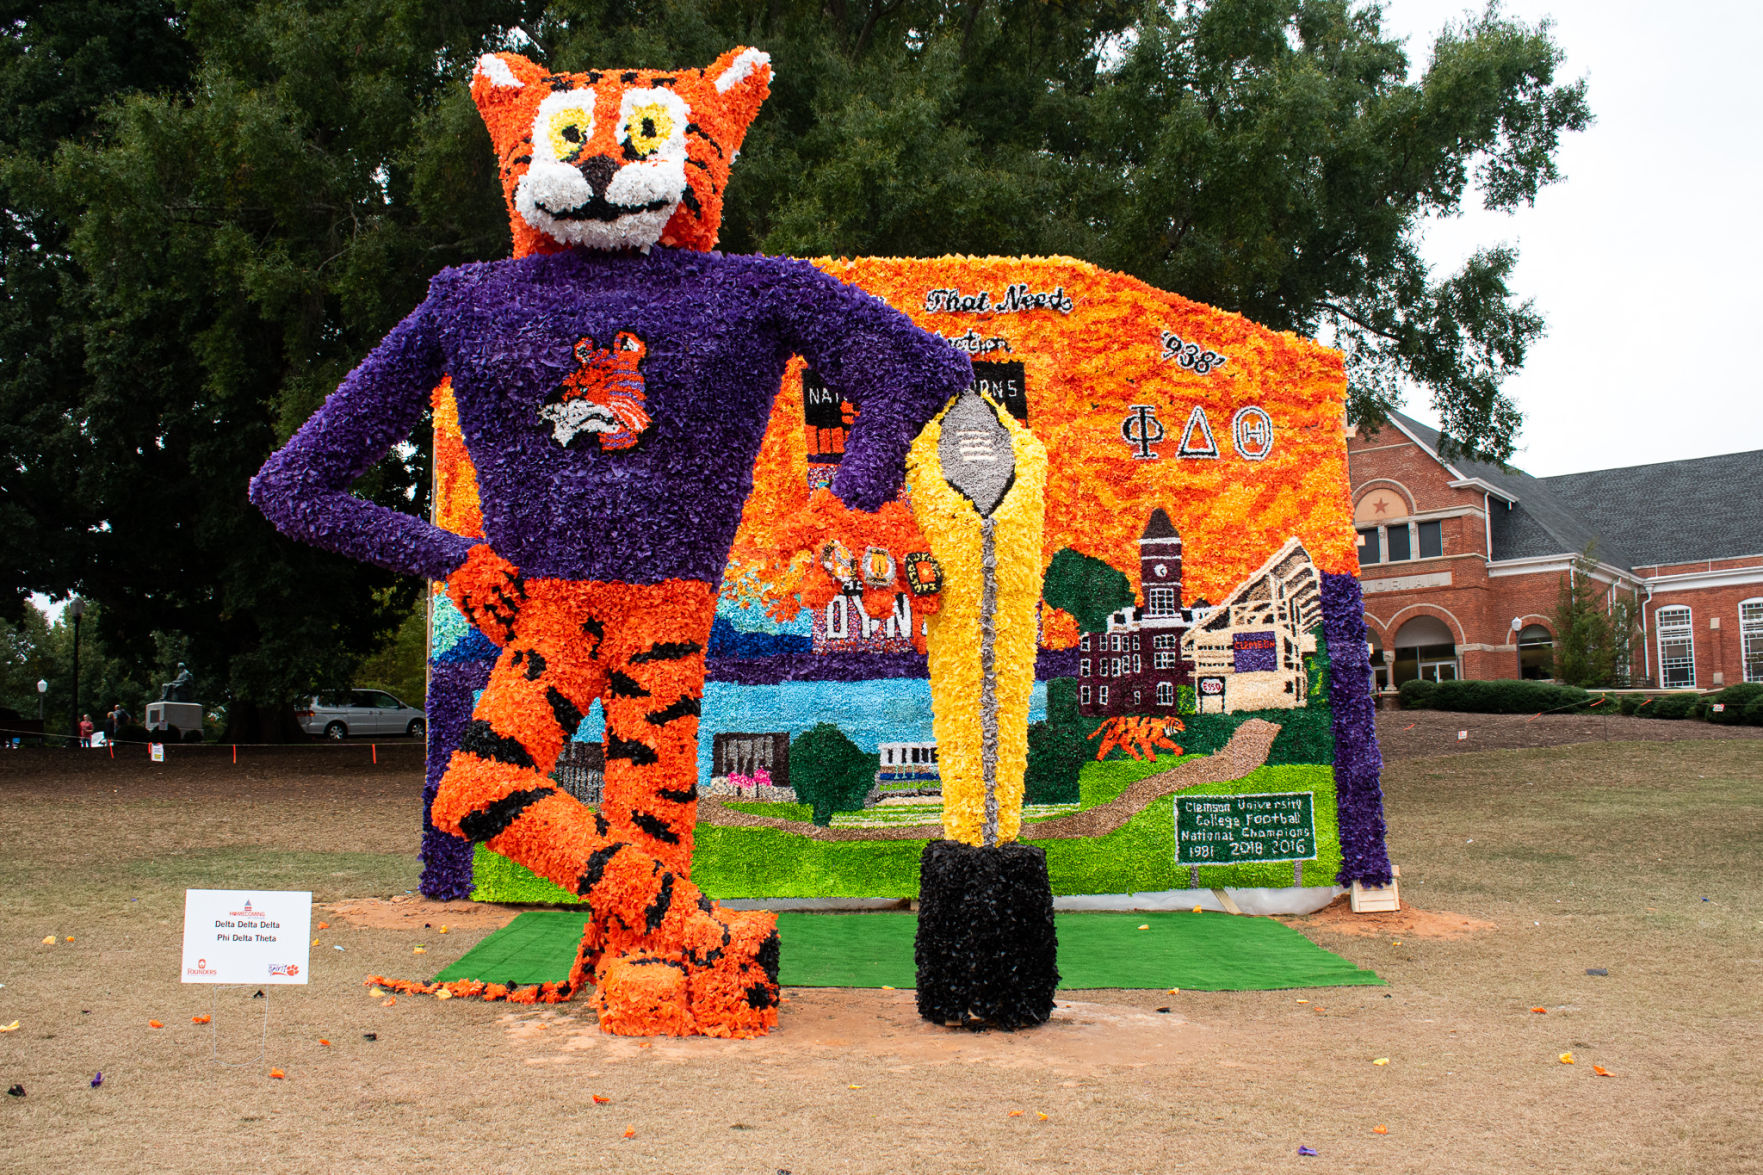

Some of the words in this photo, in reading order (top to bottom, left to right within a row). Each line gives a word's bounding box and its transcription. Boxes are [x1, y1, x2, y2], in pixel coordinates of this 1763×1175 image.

[925, 287, 990, 313] That
[994, 282, 1074, 314] Needs
[1234, 639, 1275, 650] CLEMSON
[1202, 681, 1221, 691] ESSO
[1185, 801, 1231, 813] Clemson
[1237, 798, 1302, 811] University
[1195, 814, 1240, 829] College
[1245, 812, 1301, 826] Football
[1181, 829, 1234, 841] National
[1241, 827, 1310, 839] Champions
[1189, 845, 1215, 858] 1981
[1229, 841, 1264, 856] 2018
[1271, 838, 1306, 855] 2016
[215, 920, 235, 928] Delta
[237, 921, 258, 929] Delta
[260, 921, 280, 929] Delta
[217, 934, 230, 942] Phi
[232, 934, 253, 942] Delta
[255, 935, 277, 943] Theta
